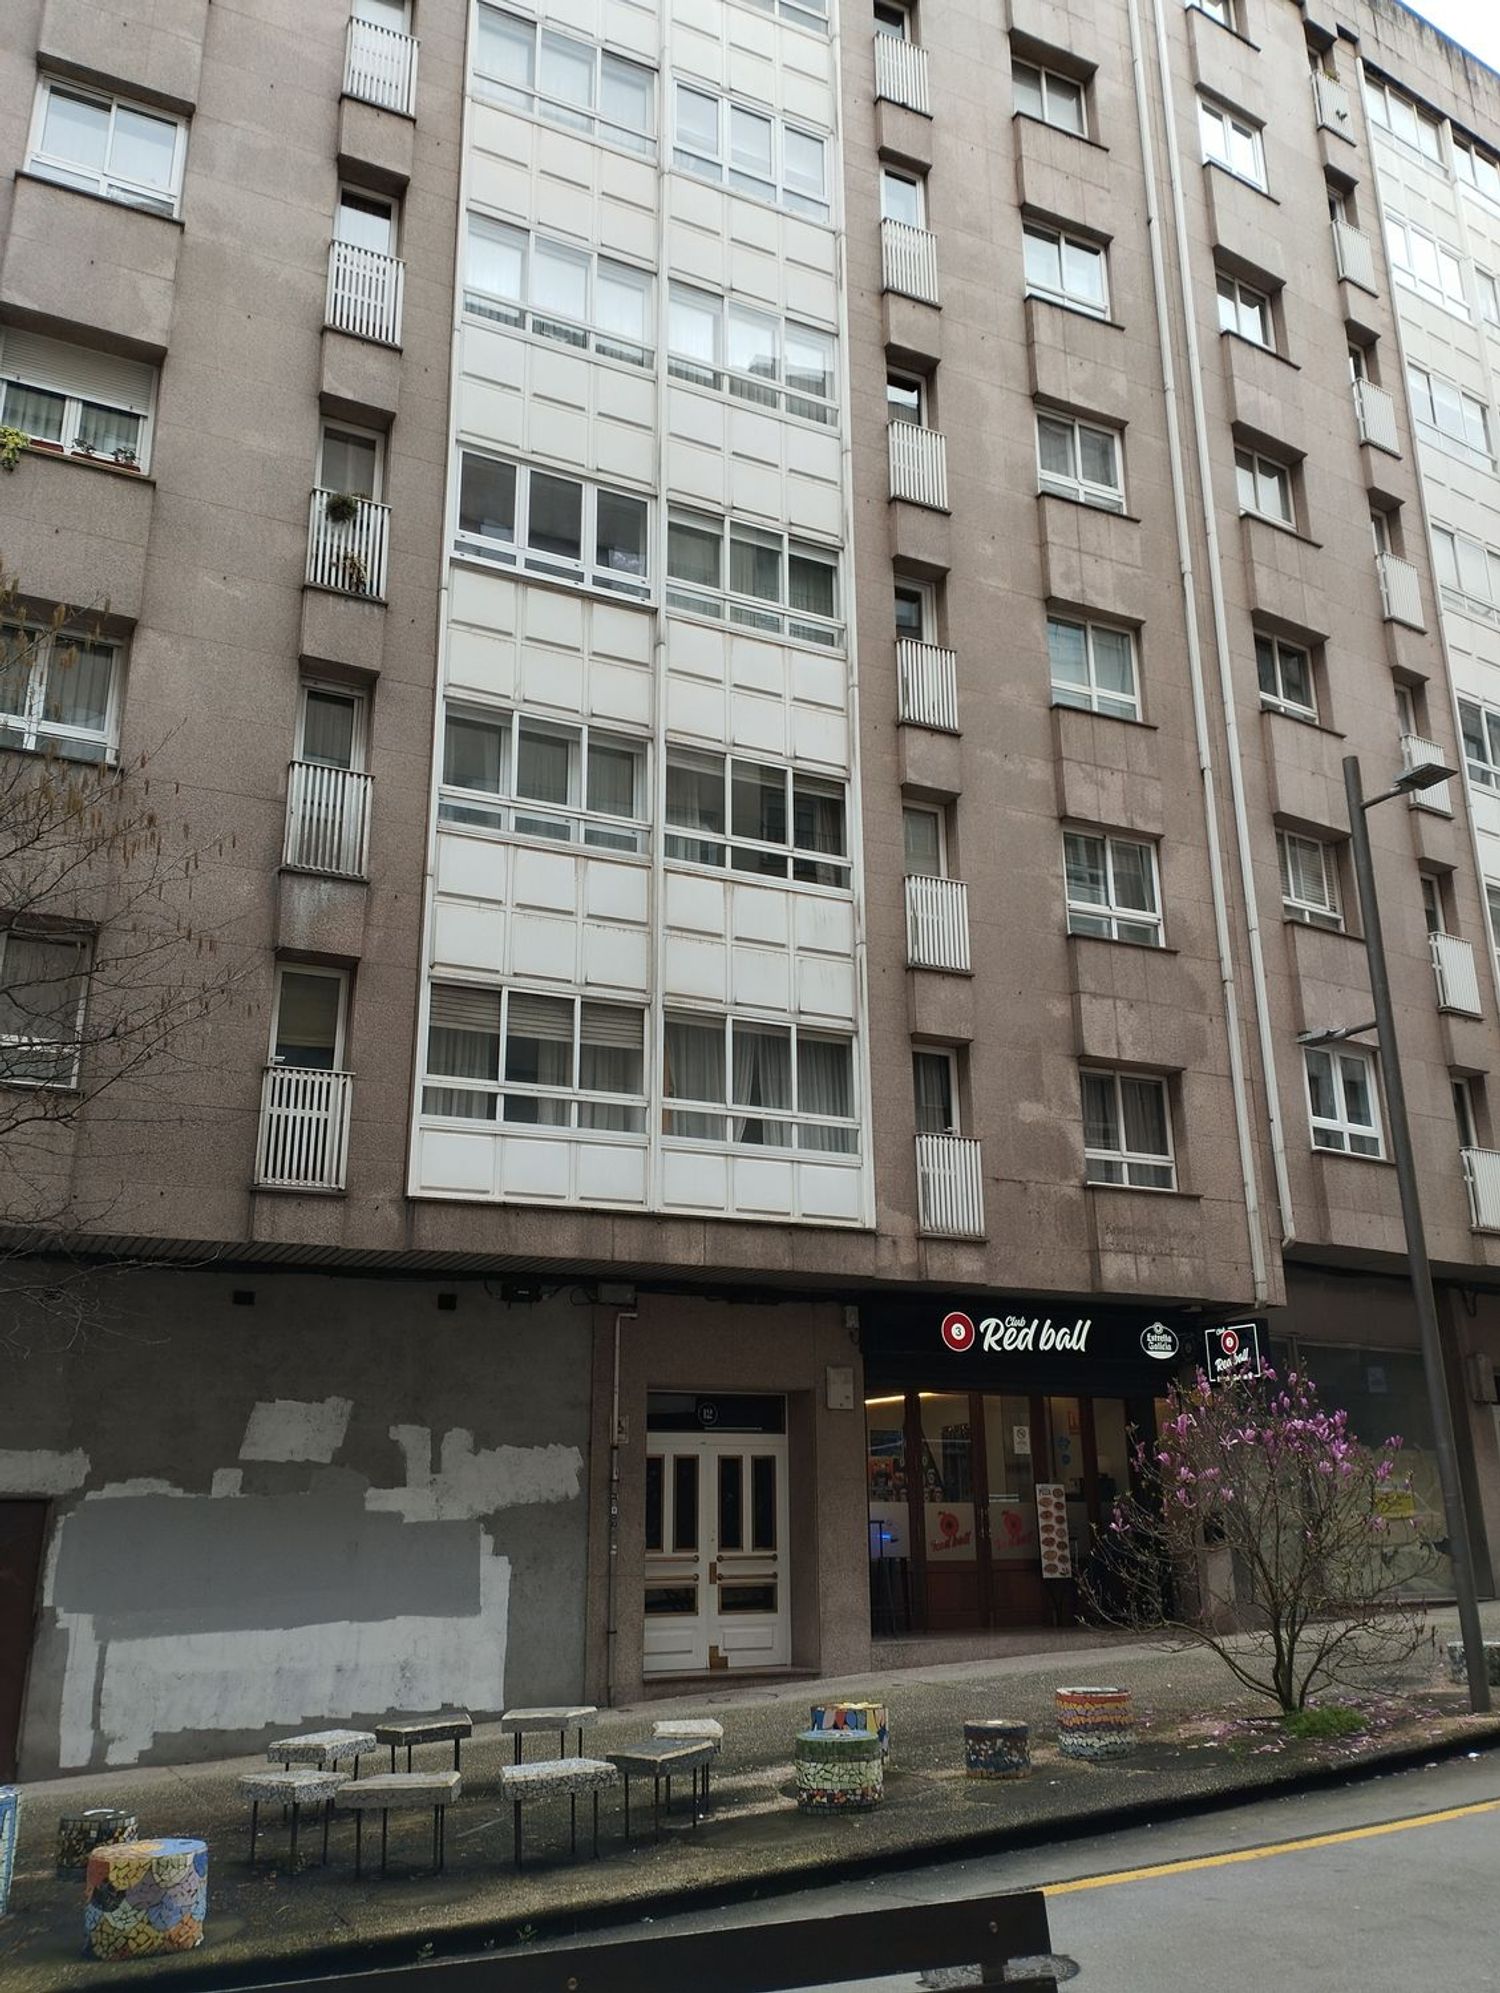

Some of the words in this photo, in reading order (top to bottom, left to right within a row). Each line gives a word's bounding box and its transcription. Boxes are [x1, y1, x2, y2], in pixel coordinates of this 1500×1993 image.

[1005, 1316, 1026, 1328] Club
[979, 1317, 1039, 1352] Red
[1039, 1319, 1092, 1352] ball
[1146, 1332, 1172, 1343] Estrella
[1147, 1341, 1172, 1351] Galicia
[703, 1408, 713, 1419] 12
